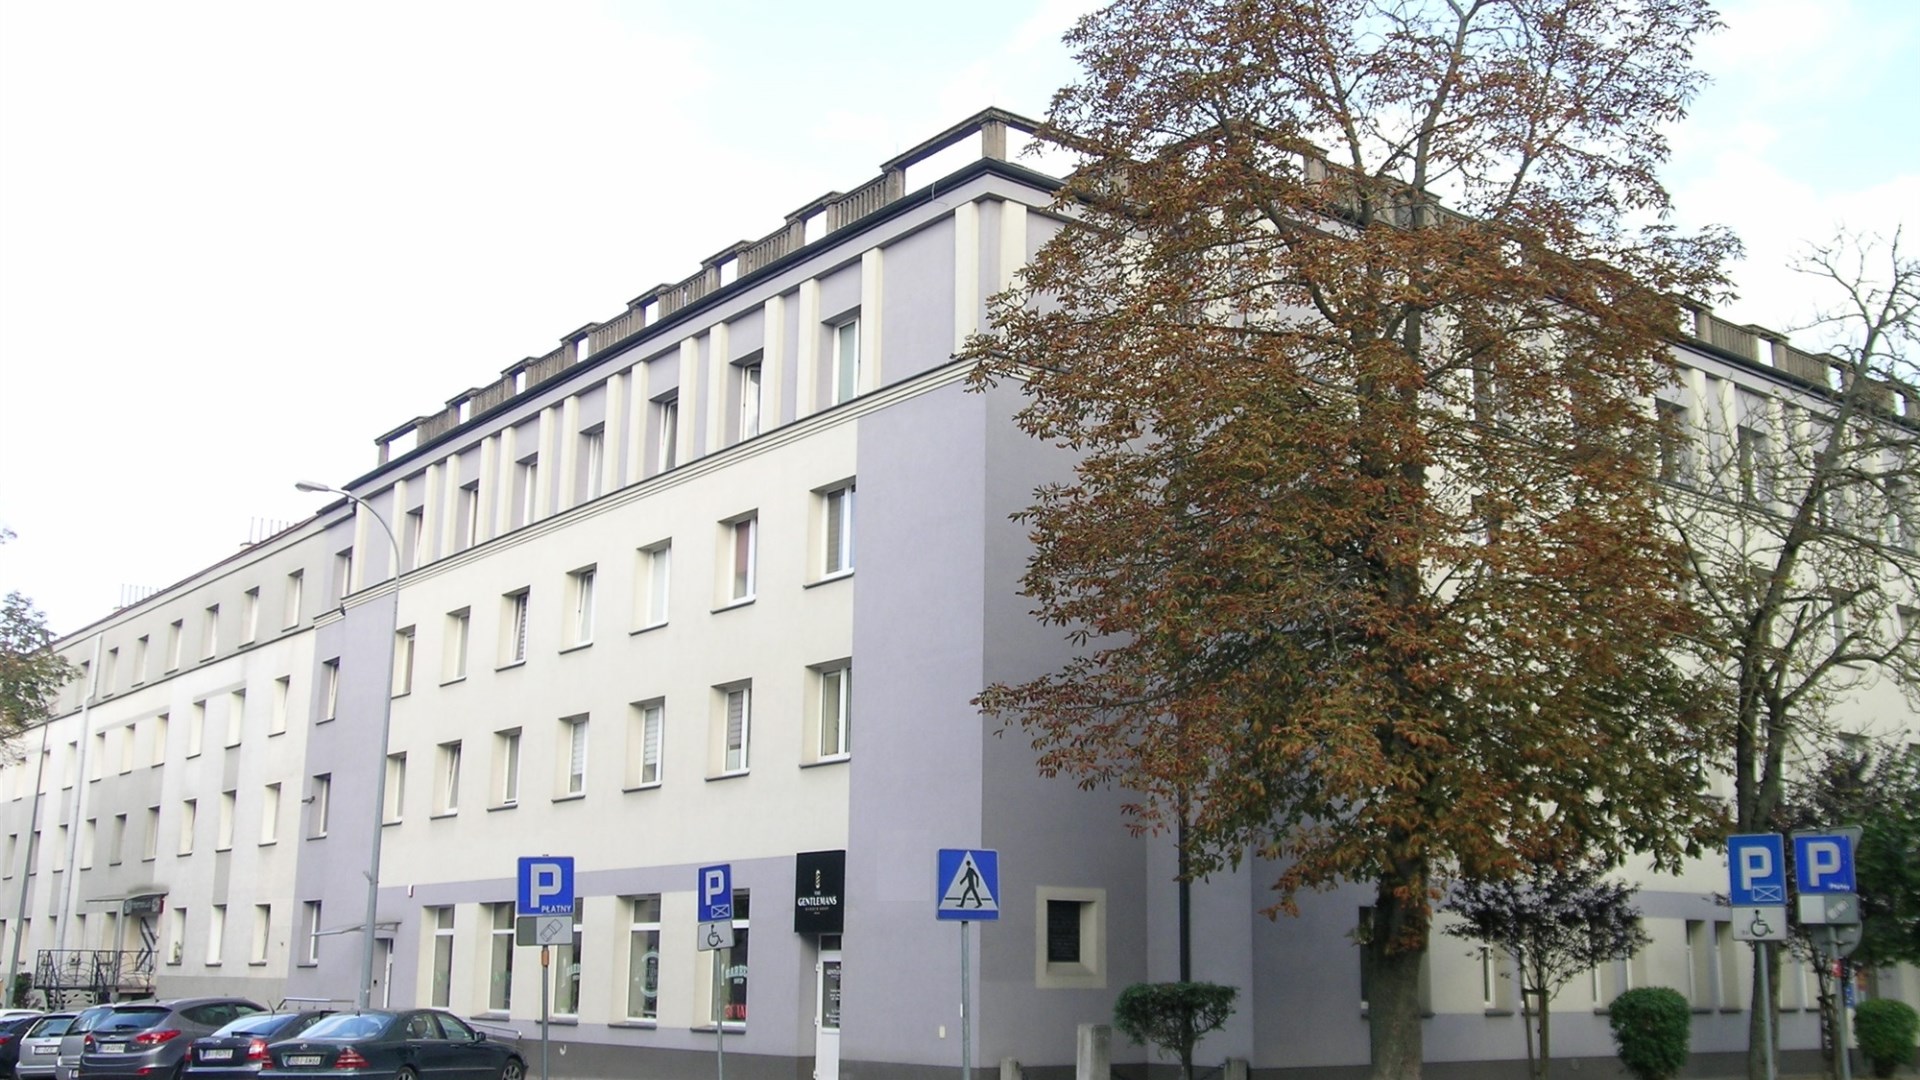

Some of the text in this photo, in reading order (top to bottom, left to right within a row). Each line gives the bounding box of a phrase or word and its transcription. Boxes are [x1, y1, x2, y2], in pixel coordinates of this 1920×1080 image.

[530, 863, 562, 908] P
[1741, 847, 1772, 891] P
[1806, 842, 1841, 887] P
[705, 870, 724, 906] P
[797, 896, 837, 906] GENTLEMANS
